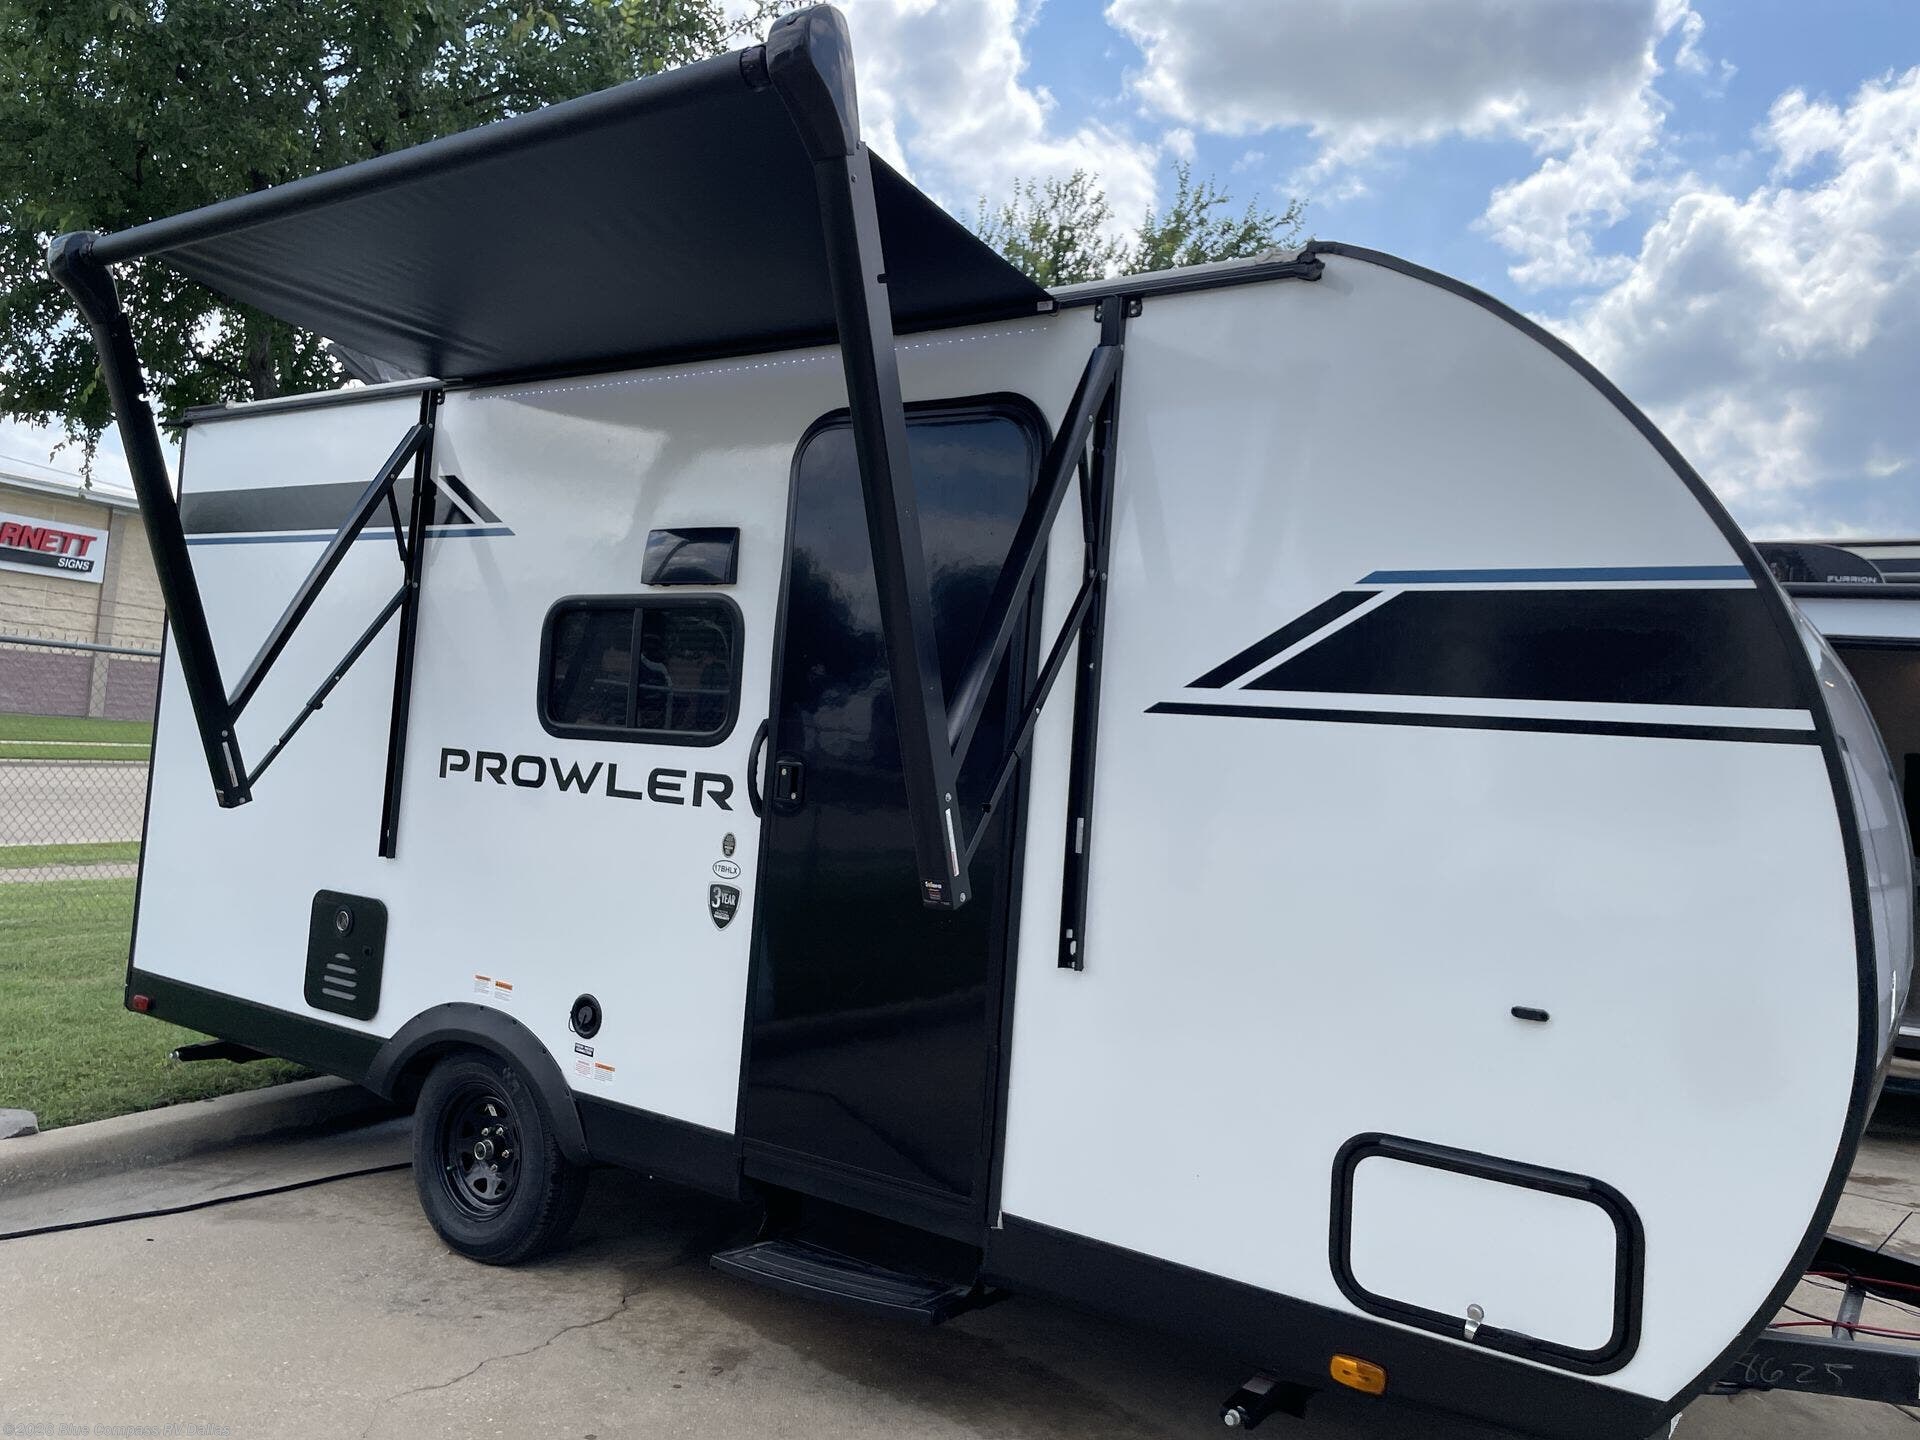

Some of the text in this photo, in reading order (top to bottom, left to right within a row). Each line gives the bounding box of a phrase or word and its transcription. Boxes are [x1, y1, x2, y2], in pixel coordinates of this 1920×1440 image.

[57, 557, 90, 571] SIGNS
[1827, 575, 1877, 583] FURRION
[439, 747, 734, 811] PROWLER
[711, 886, 736, 908] 3 YEAR
